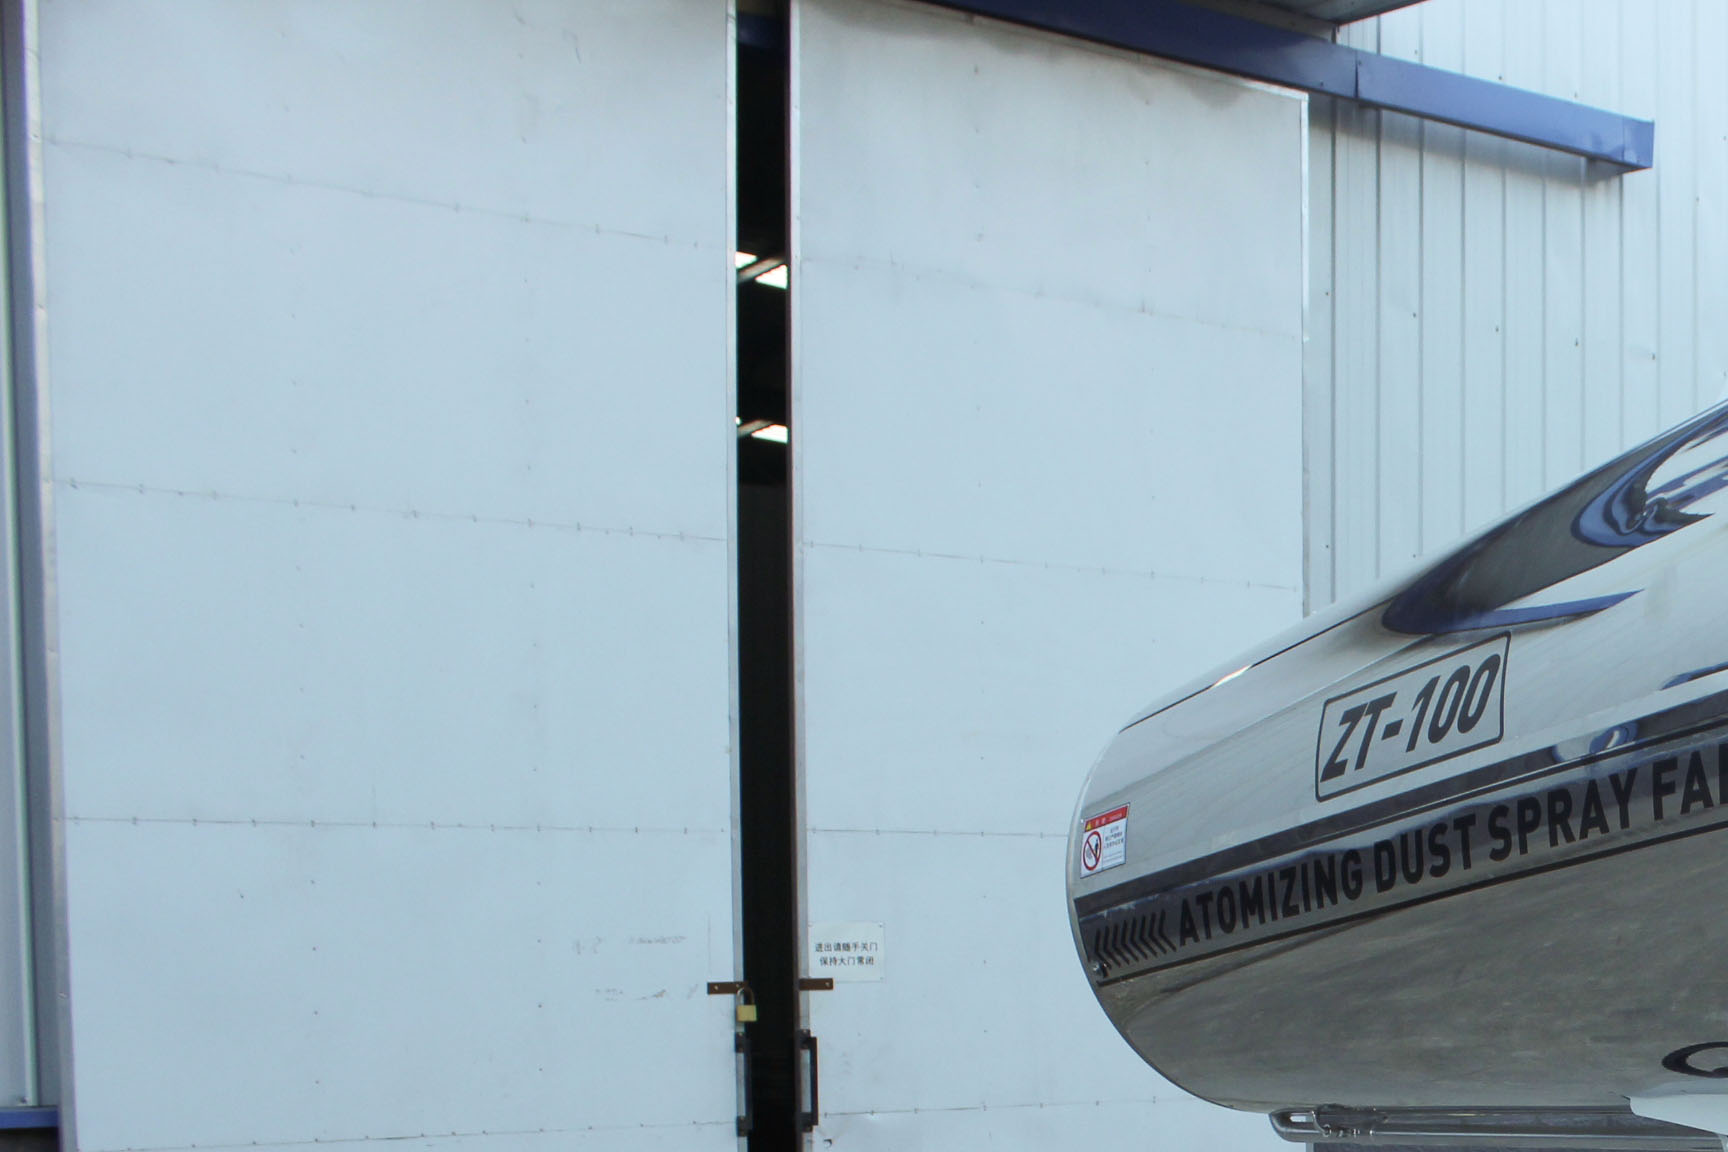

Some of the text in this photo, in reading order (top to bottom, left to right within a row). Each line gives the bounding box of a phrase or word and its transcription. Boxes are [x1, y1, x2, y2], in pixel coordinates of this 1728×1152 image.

[1320, 653, 1501, 783] ZT-100
[1180, 850, 1364, 947] ATOMIZING
[1374, 813, 1477, 894] DUST
[1488, 767, 1638, 862] SPRAY
